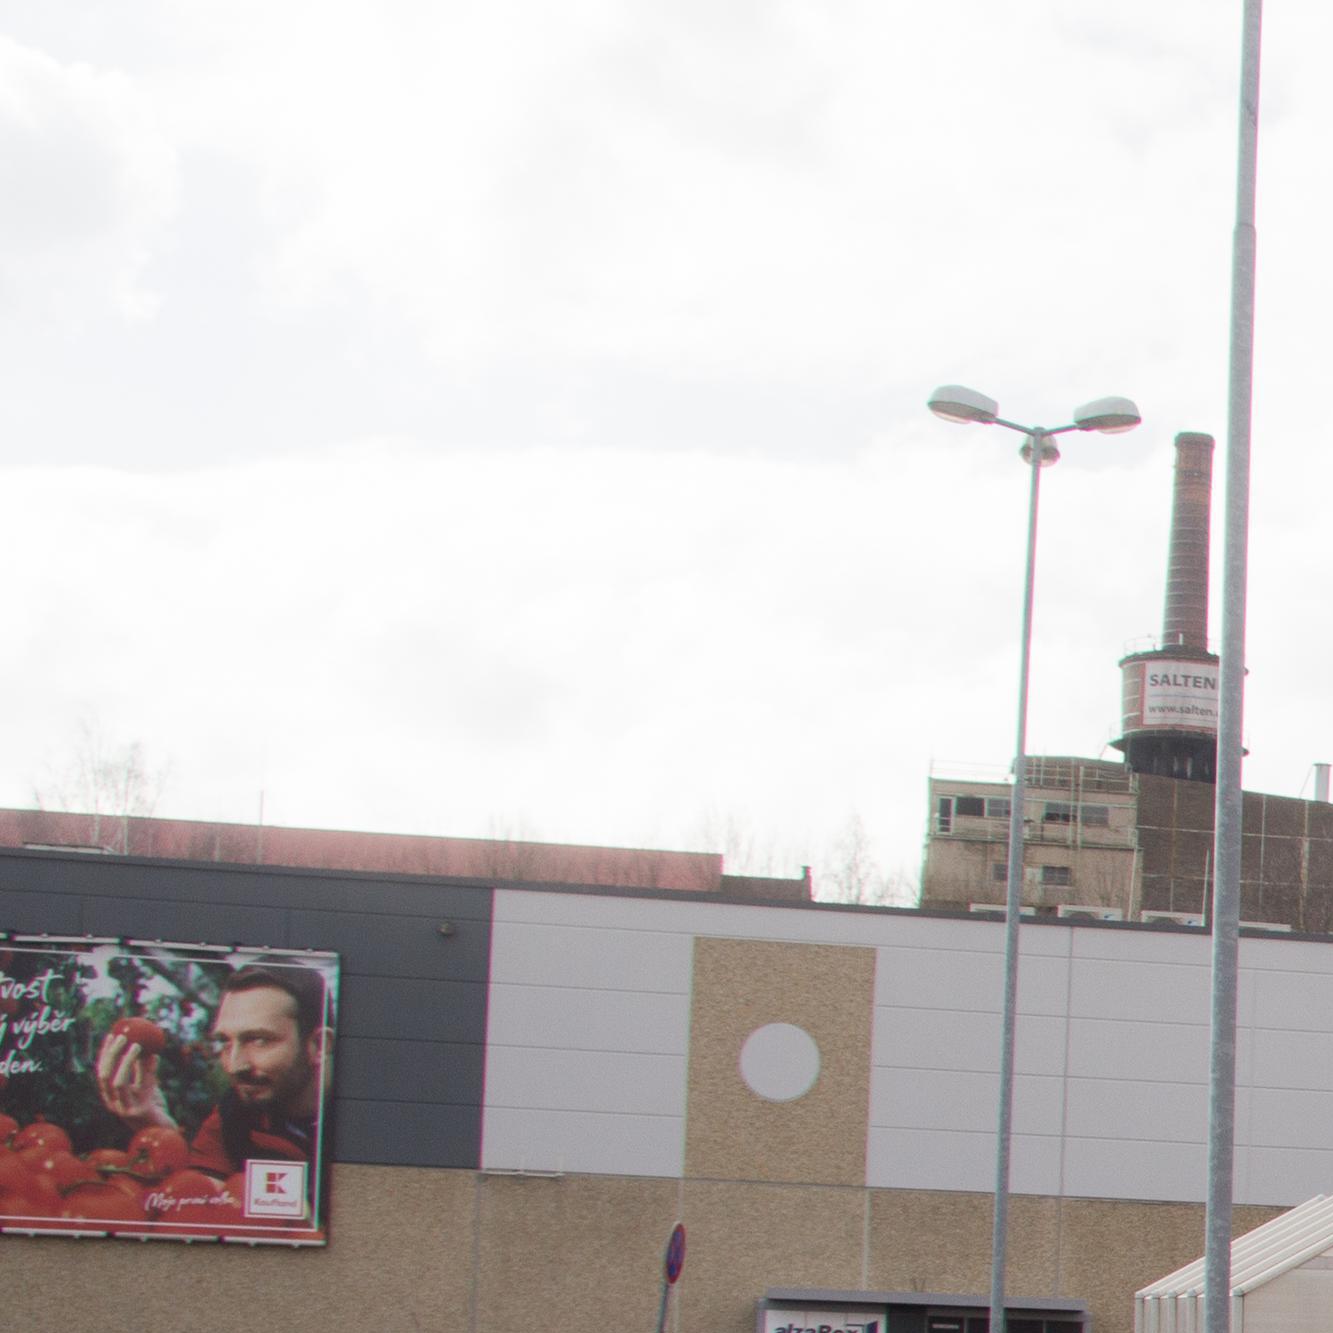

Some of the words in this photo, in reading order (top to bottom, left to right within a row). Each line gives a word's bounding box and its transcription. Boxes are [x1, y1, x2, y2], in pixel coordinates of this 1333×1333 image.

[1150, 674, 1215, 690] SALTEN
[1148, 704, 1218, 718] www.salten.
[0, 969, 63, 1003] vost
[13, 1006, 75, 1050] výběr
